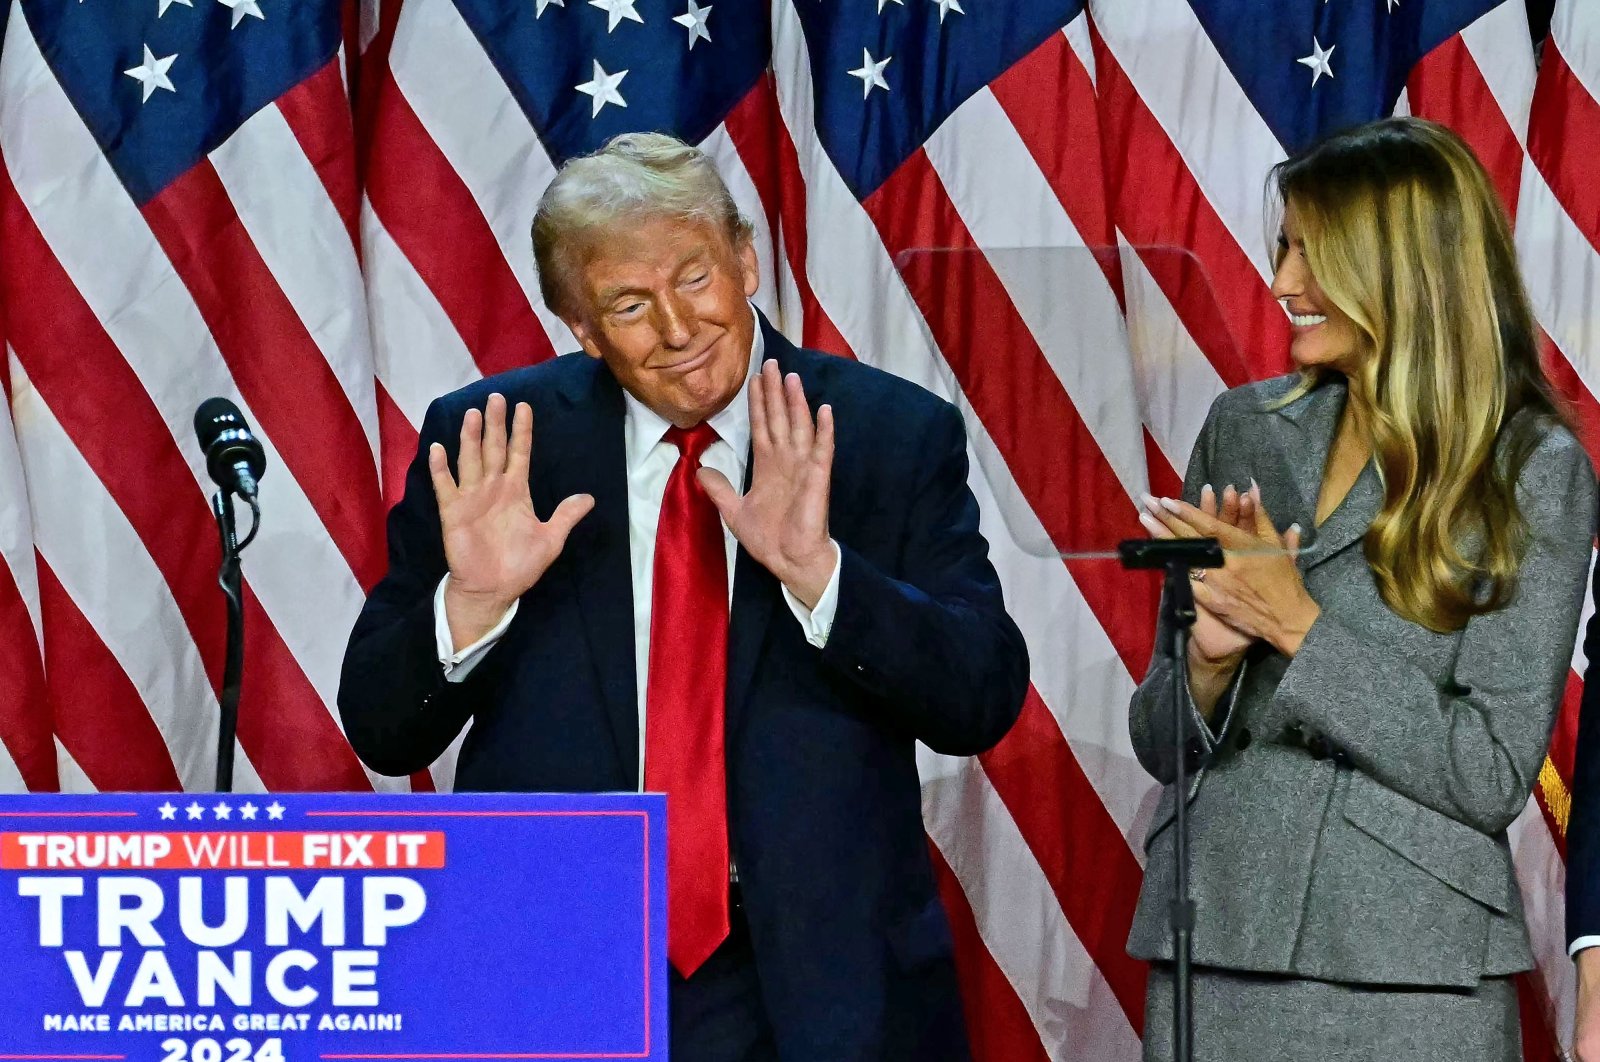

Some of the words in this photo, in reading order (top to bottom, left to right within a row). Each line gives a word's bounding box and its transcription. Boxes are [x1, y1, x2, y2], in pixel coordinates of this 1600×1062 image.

[18, 834, 171, 867] TRUMP
[183, 834, 290, 867] WILL
[303, 834, 374, 866] FIX
[386, 834, 427, 866] IT
[18, 876, 427, 947] TRUMP
[64, 949, 379, 1007] VANCE
[43, 1014, 111, 1031] MAKE
[118, 1014, 225, 1031] AMERICA
[233, 1013, 311, 1031] GREAT
[318, 1013, 402, 1031] AGAIN!
[160, 1037, 285, 1062] 2024
